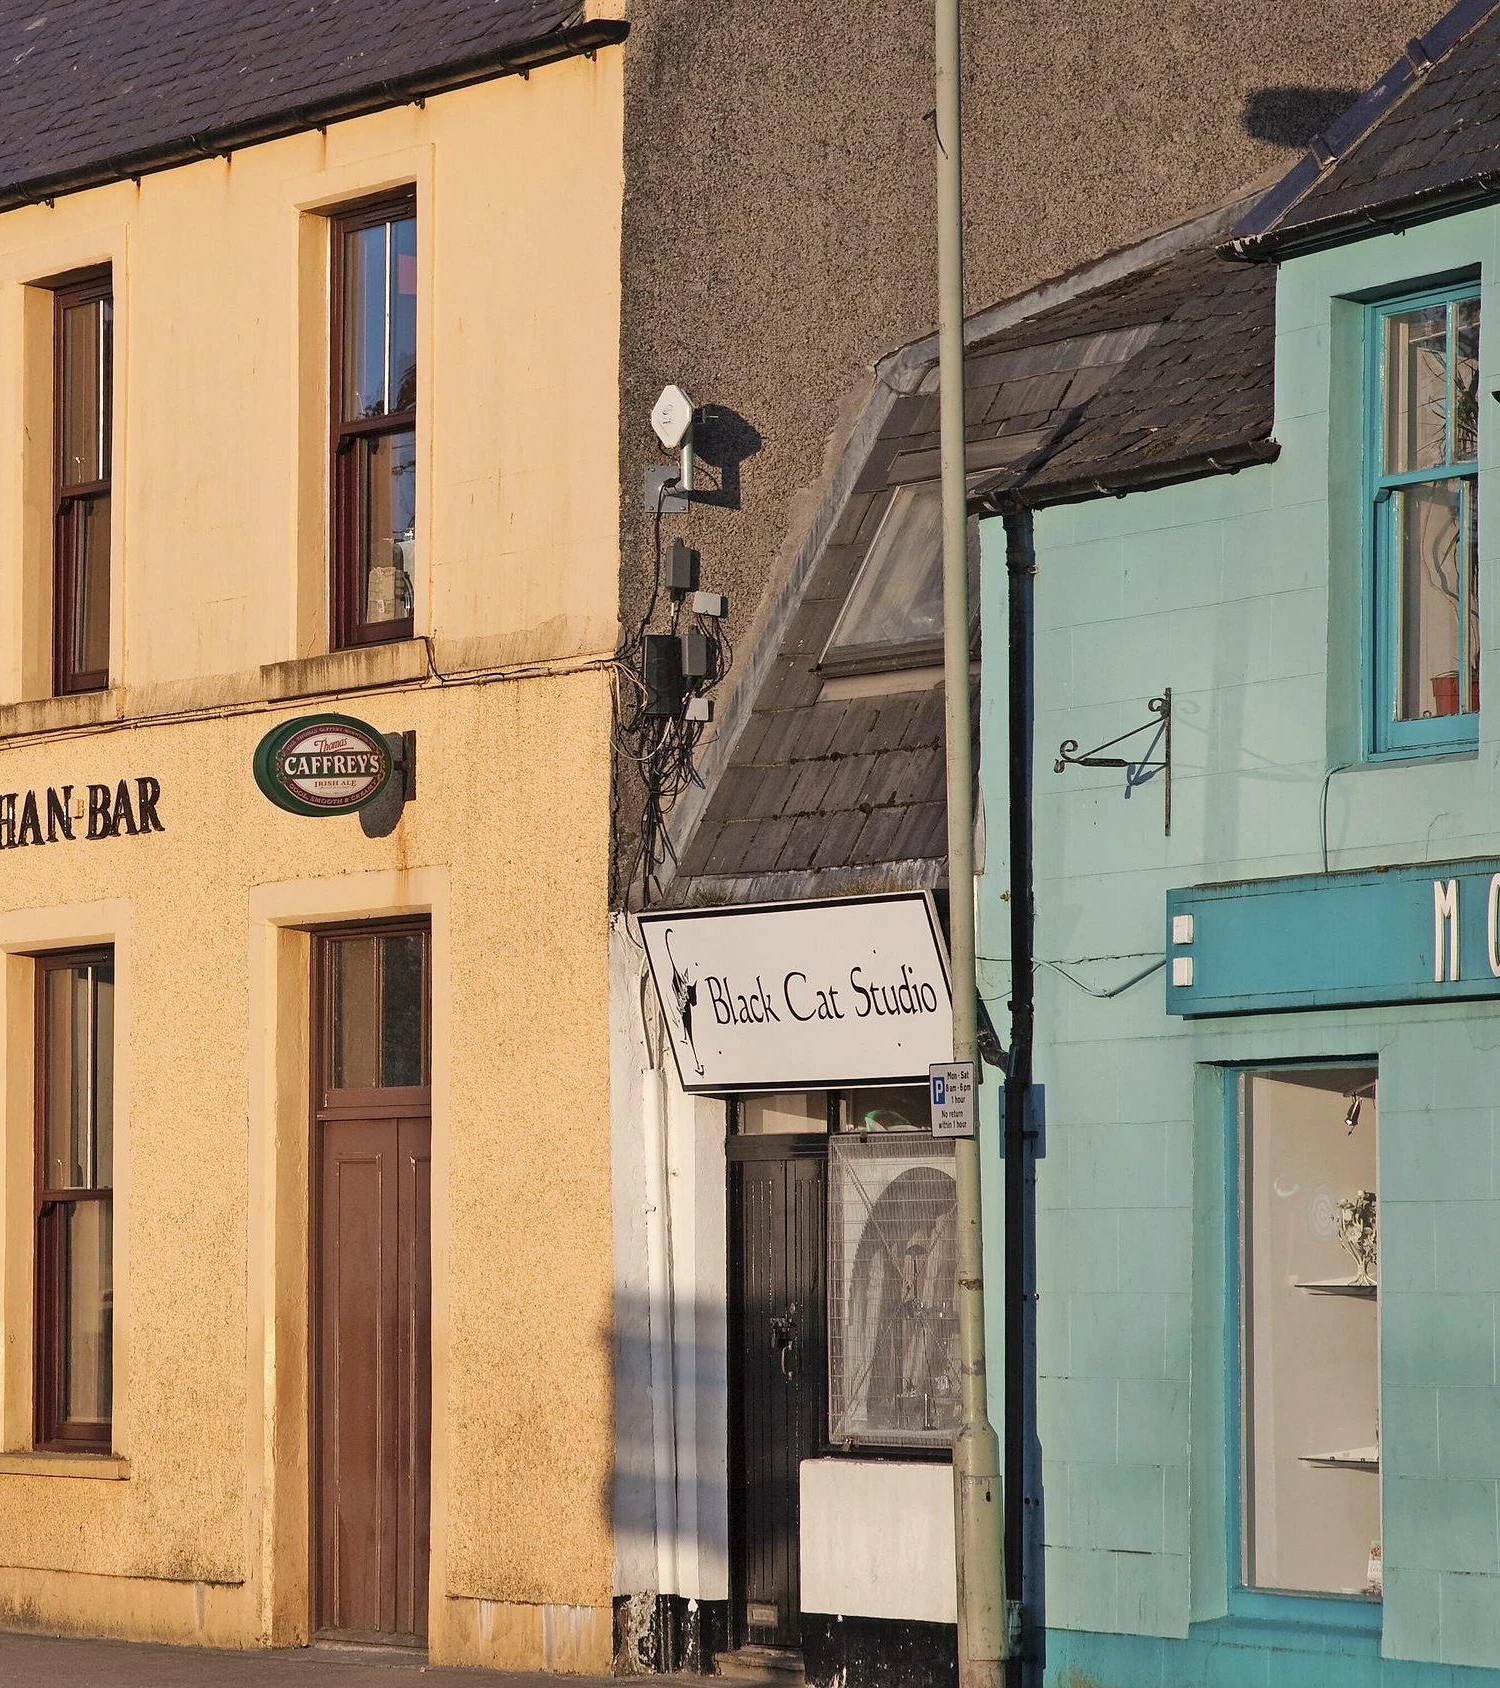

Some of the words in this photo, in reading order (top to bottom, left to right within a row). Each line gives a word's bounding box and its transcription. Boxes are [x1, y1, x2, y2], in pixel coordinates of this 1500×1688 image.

[314, 737, 348, 752] Thomas
[284, 754, 380, 776] CAFFREY'S
[314, 780, 339, 788] IRISH
[341, 779, 357, 787] ALE
[310, 795, 344, 805] SMOOTH
[350, 781, 377, 802] CREAMY
[85, 777, 165, 840] BAR
[704, 975, 781, 1026] Black
[783, 971, 845, 1022] Cat
[850, 964, 938, 1018] Studio
[947, 1071, 957, 1080] Mon
[960, 1071, 969, 1080] Sat
[935, 1080, 943, 1102] P
[955, 1095, 966, 1103] hour
[941, 1110, 948, 1118] No
[949, 1110, 964, 1118] return
[939, 1121, 952, 1129] within
[956, 1120, 967, 1128] hour
